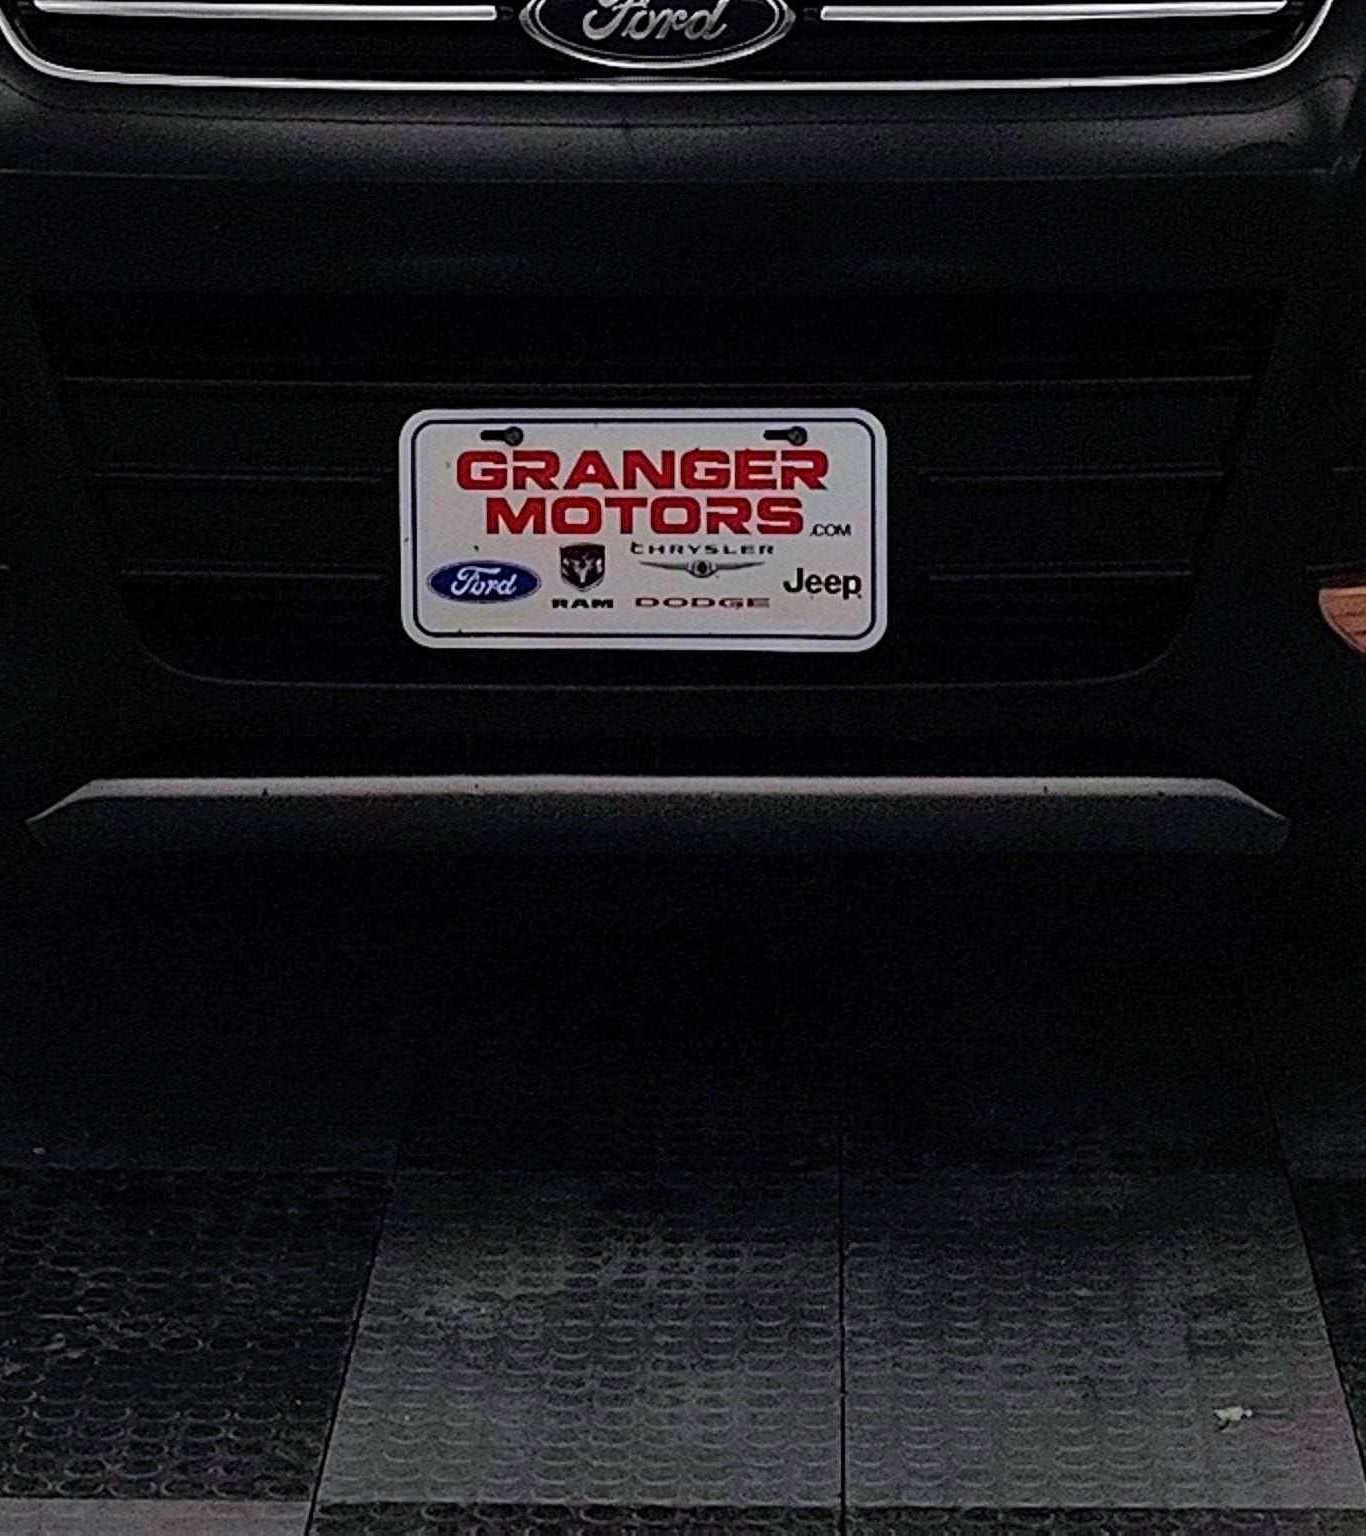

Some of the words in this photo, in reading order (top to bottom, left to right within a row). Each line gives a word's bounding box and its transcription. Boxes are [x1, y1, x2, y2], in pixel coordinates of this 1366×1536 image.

[456, 449, 829, 490] GRANGER
[486, 497, 804, 535] MOTORS
[630, 542, 774, 555] CHRYSLER
[450, 566, 518, 597] Ford
[783, 567, 863, 599] Jeep
[551, 598, 615, 609] RAM
[635, 597, 771, 608] DODGE
